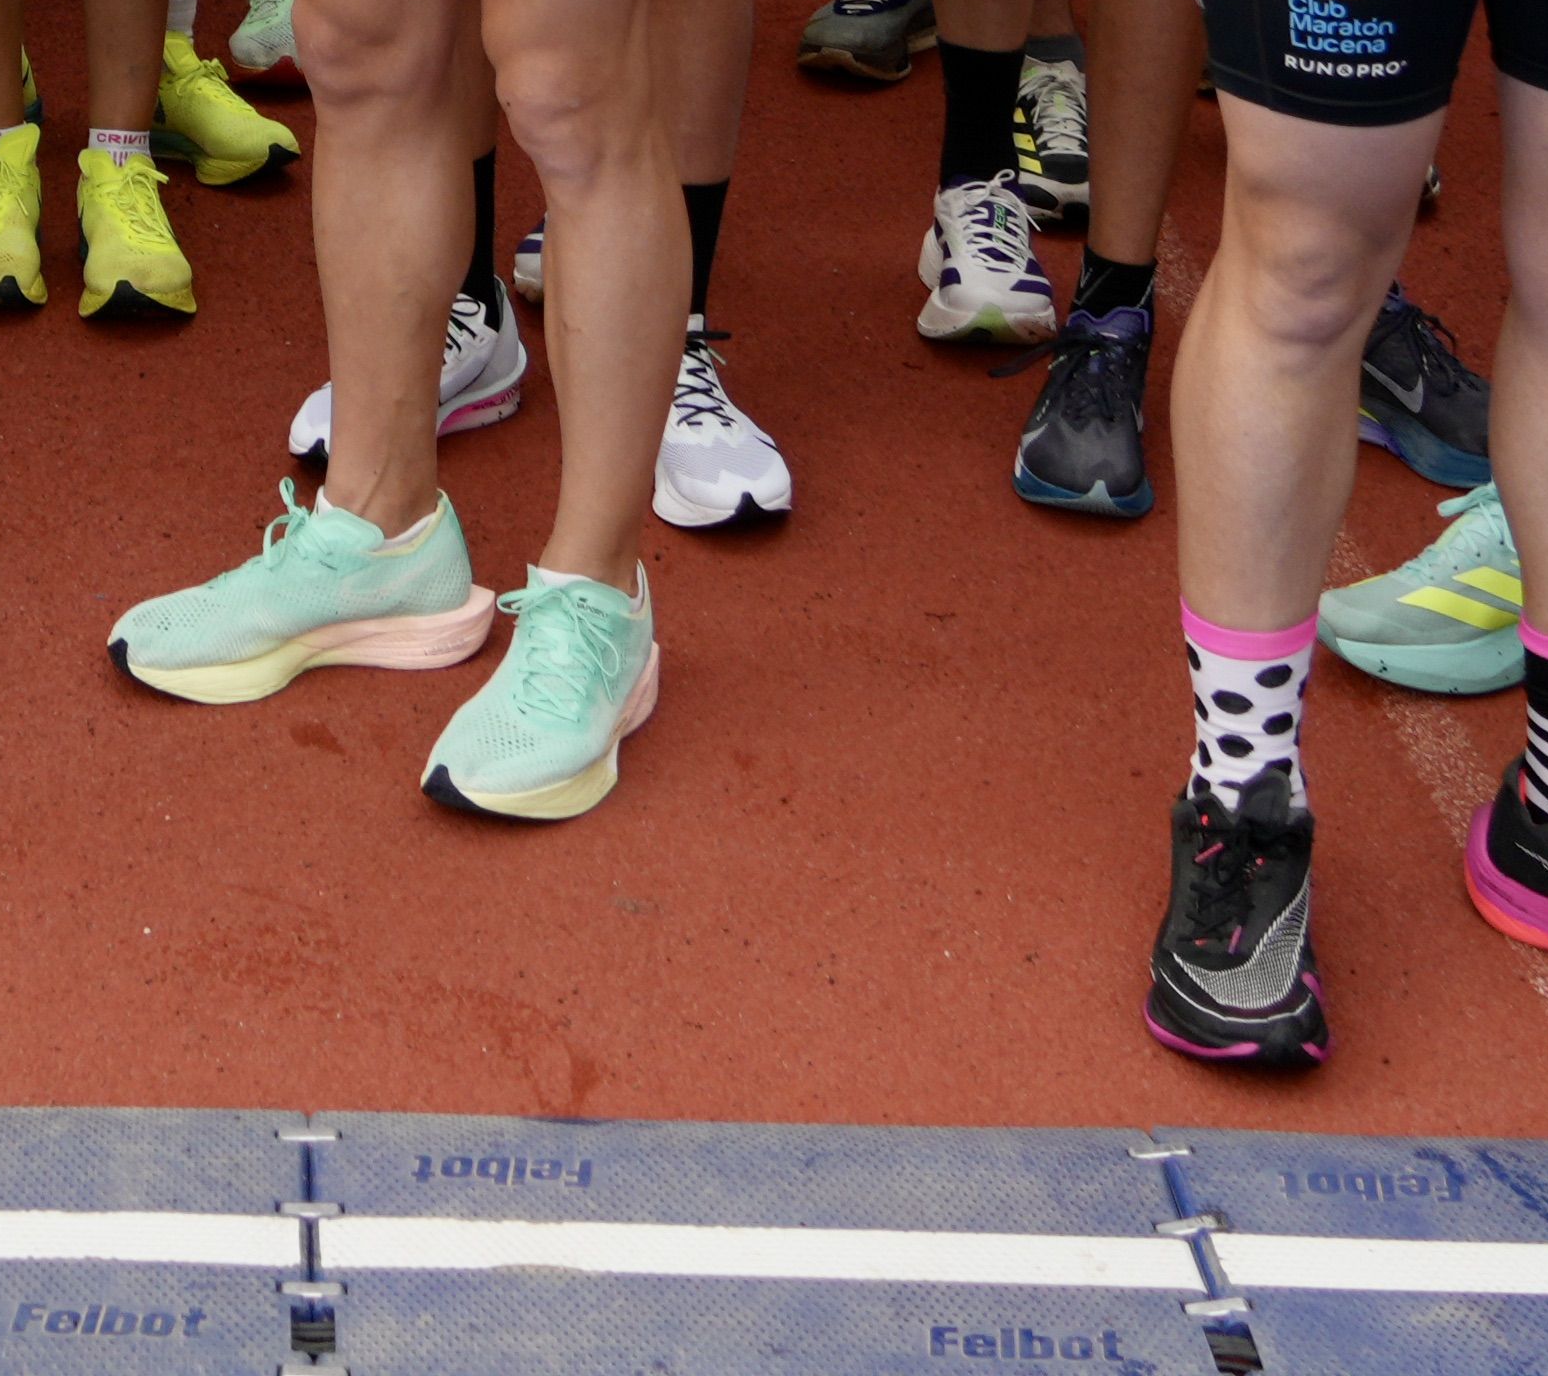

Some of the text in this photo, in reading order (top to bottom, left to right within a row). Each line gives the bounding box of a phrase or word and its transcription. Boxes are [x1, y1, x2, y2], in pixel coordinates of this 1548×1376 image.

[1289, 11, 1395, 37] Maratón
[1289, 28, 1387, 54] Lucena
[408, 1153, 594, 1189] Felbot
[1276, 1165, 1464, 1202] Felbot
[9, 1302, 208, 1337] Felbot
[929, 1325, 1126, 1363] Felbot
